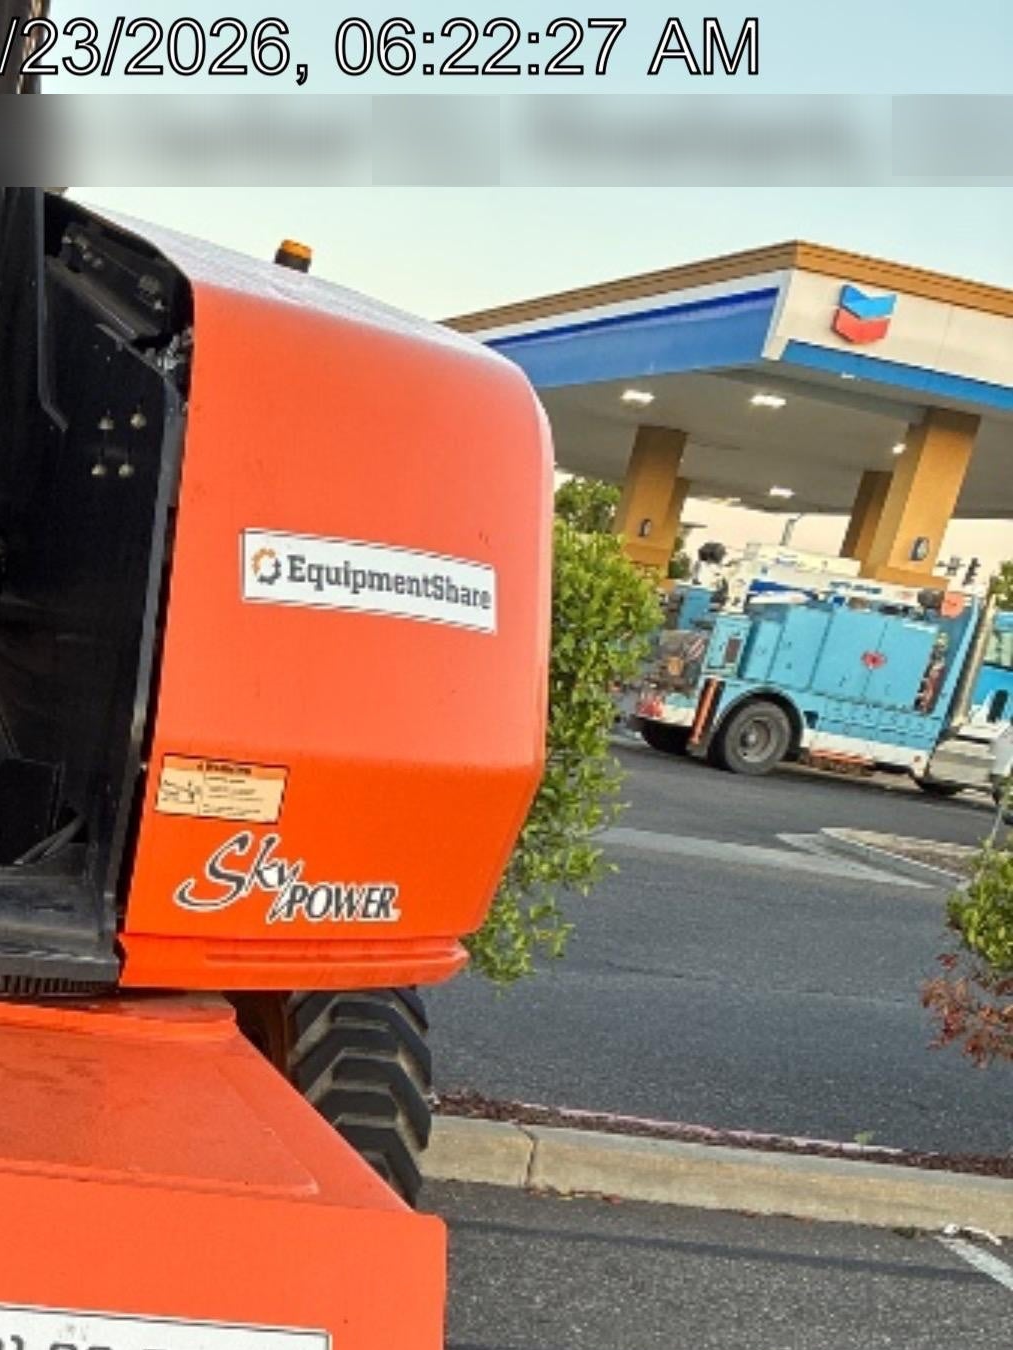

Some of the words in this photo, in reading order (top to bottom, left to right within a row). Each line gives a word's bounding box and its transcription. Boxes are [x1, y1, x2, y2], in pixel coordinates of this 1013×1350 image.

[287, 554, 493, 611] EquipmentShare
[175, 831, 303, 923] Sky
[282, 882, 399, 920] POWER
